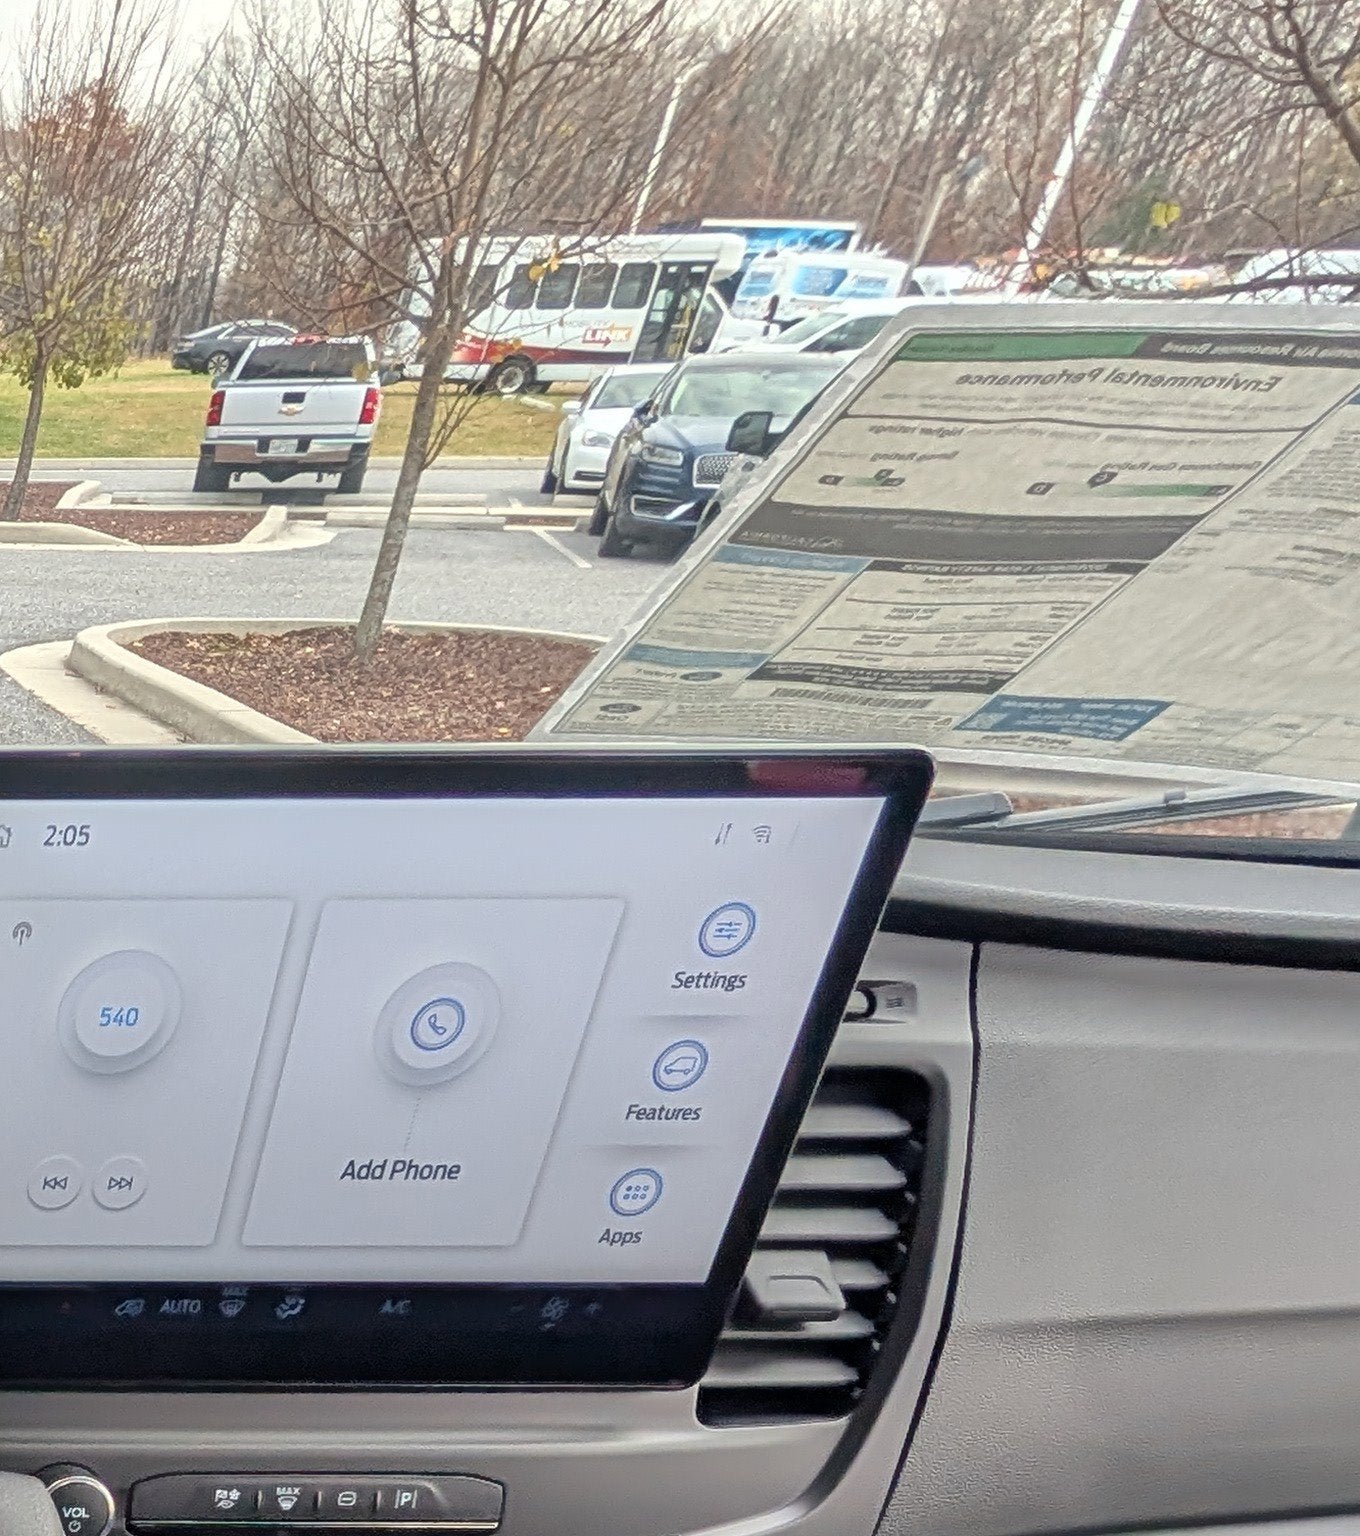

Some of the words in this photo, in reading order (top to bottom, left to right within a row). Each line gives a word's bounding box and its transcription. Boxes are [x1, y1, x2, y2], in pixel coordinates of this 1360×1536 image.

[43, 824, 91, 847] 2:05
[671, 971, 748, 993] Settings
[99, 1006, 139, 1027] 540
[625, 1104, 702, 1121] Features
[339, 1158, 388, 1180] Add
[388, 1158, 462, 1180] Phone
[598, 1227, 643, 1247] Apps
[159, 1299, 201, 1314] AUTO
[276, 1487, 301, 1496] MAX
[62, 1506, 89, 1518] VOL
